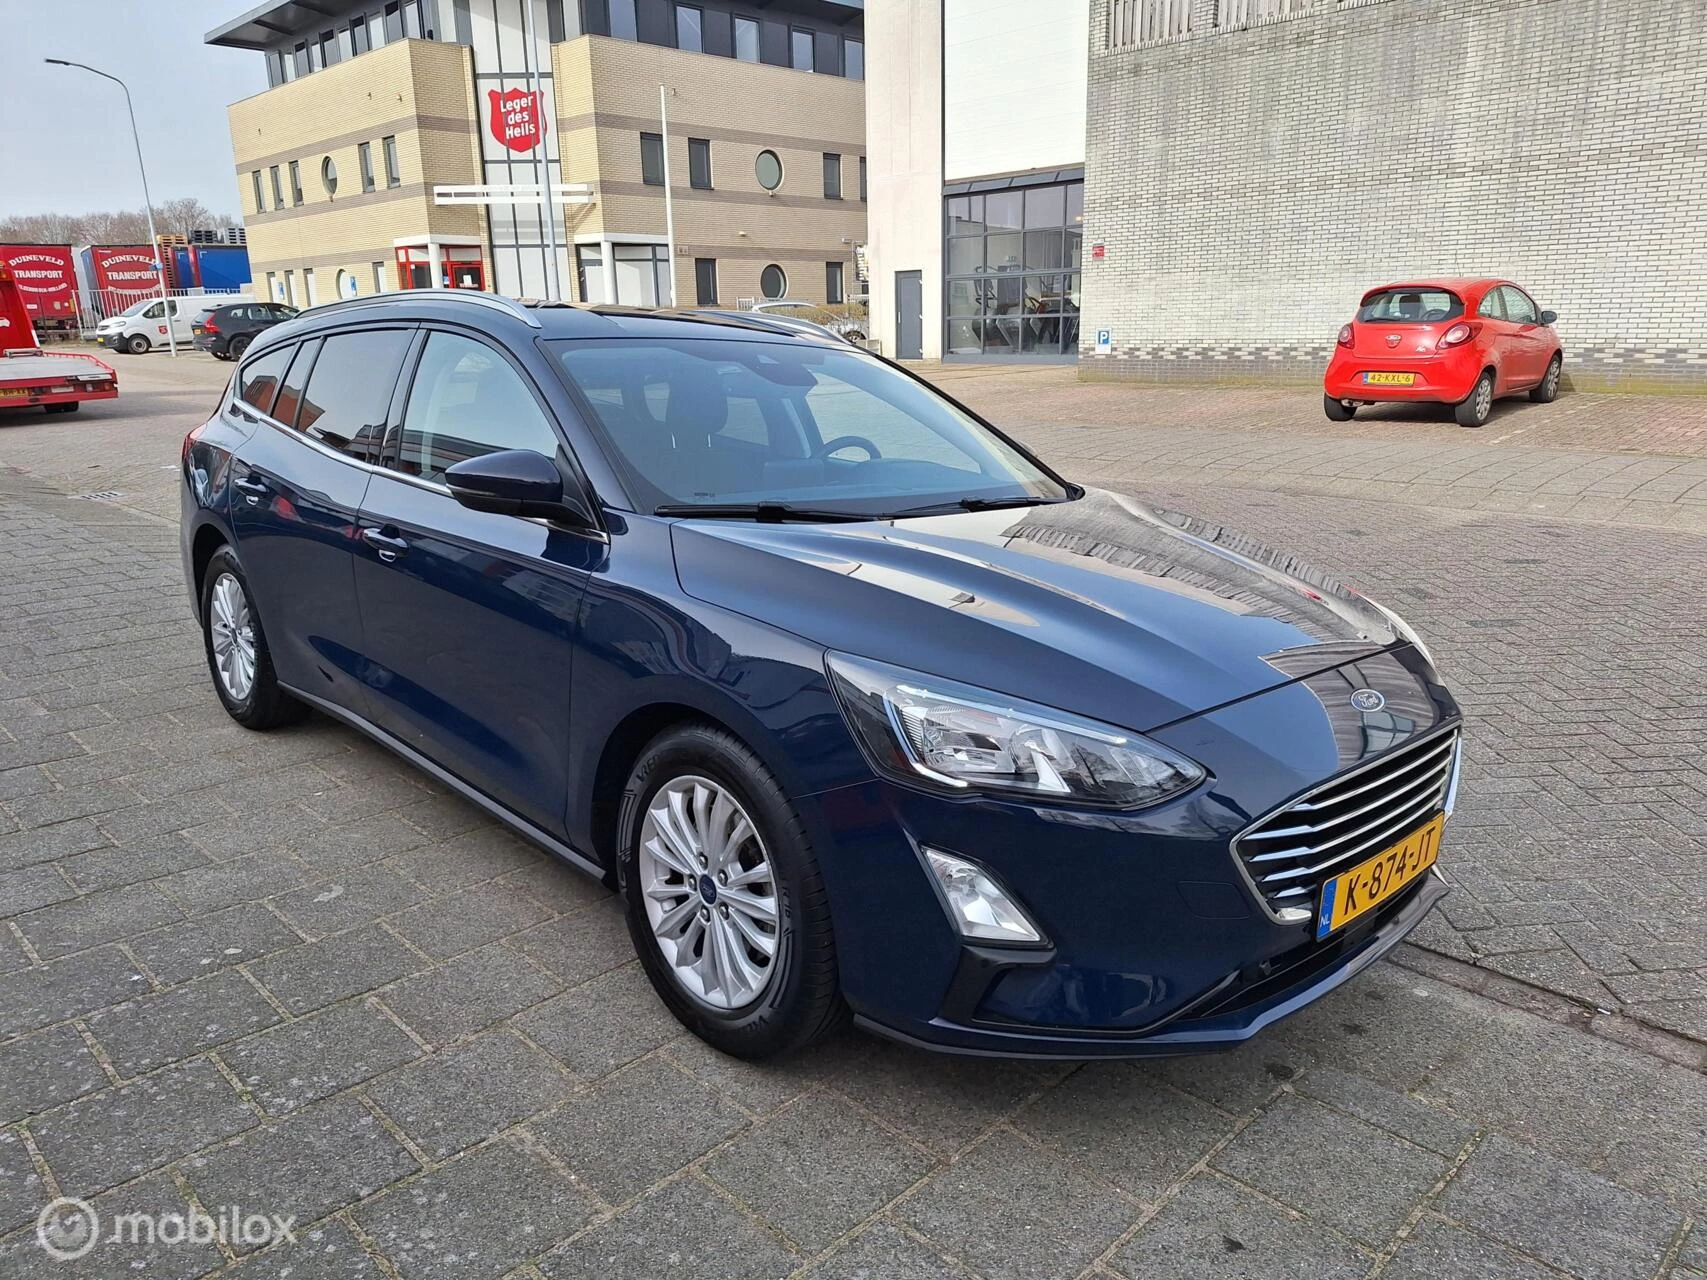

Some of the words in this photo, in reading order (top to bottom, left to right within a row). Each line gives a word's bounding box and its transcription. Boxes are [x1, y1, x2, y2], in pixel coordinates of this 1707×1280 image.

[500, 96, 533, 113] Leger
[507, 111, 529, 125] des
[505, 123, 536, 139] Heils
[9, 254, 64, 267] DUINEVELD
[14, 270, 63, 278] TRANSPORT
[107, 271, 158, 280] TRANSPORT
[1100, 331, 1108, 344] P
[1370, 373, 1411, 383] 42-KXL-6
[1344, 826, 1436, 916] K-874-JT
[1319, 912, 1330, 928] NL
